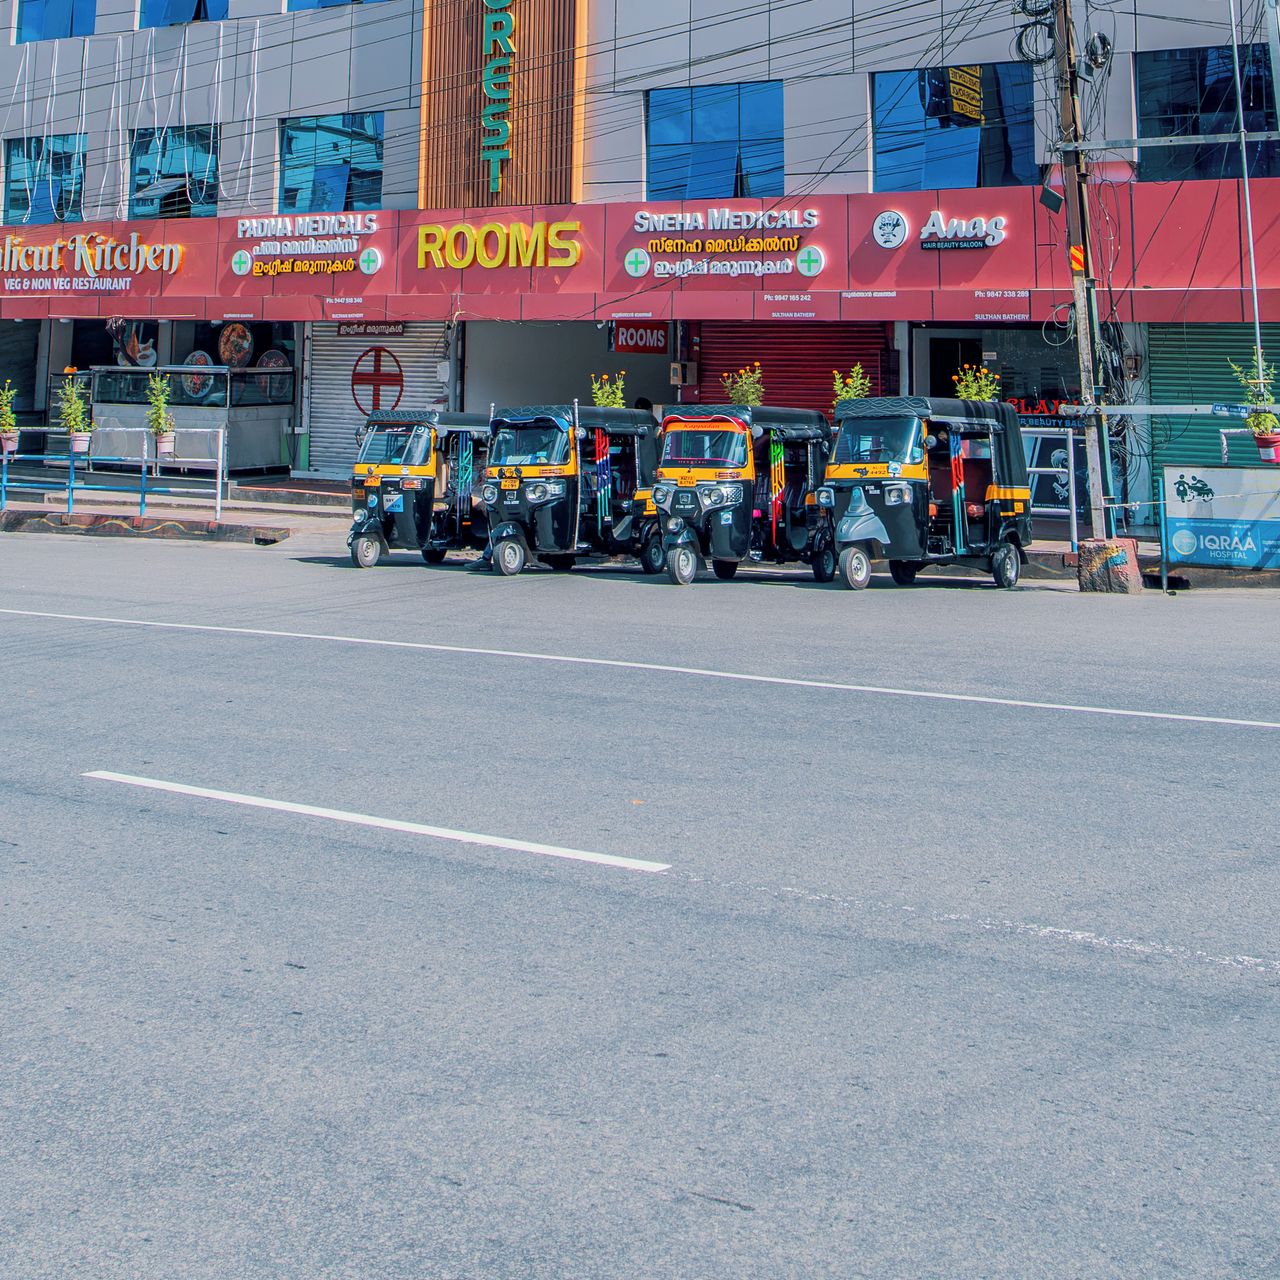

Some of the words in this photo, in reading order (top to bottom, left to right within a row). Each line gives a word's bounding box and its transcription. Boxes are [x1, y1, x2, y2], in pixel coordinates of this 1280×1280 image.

[238, 216, 292, 238] PADMA
[295, 214, 379, 236] MEDICALS
[634, 211, 704, 232] SNEHA
[708, 208, 818, 230] MEDICALS
[920, 210, 1008, 246] Anas
[68, 231, 184, 278] Kitchen
[417, 221, 581, 269] ROOMS
[922, 241, 937, 249] HAIR
[937, 241, 959, 249] BEAUTY
[4, 278, 21, 290] VEG
[22, 278, 30, 289] &
[31, 278, 51, 290] NON
[53, 278, 70, 290] VEG
[72, 277, 132, 290] RESTAURANT
[619, 328, 665, 347] ROOMS
[1210, 551, 1248, 559] HOSPITAL
